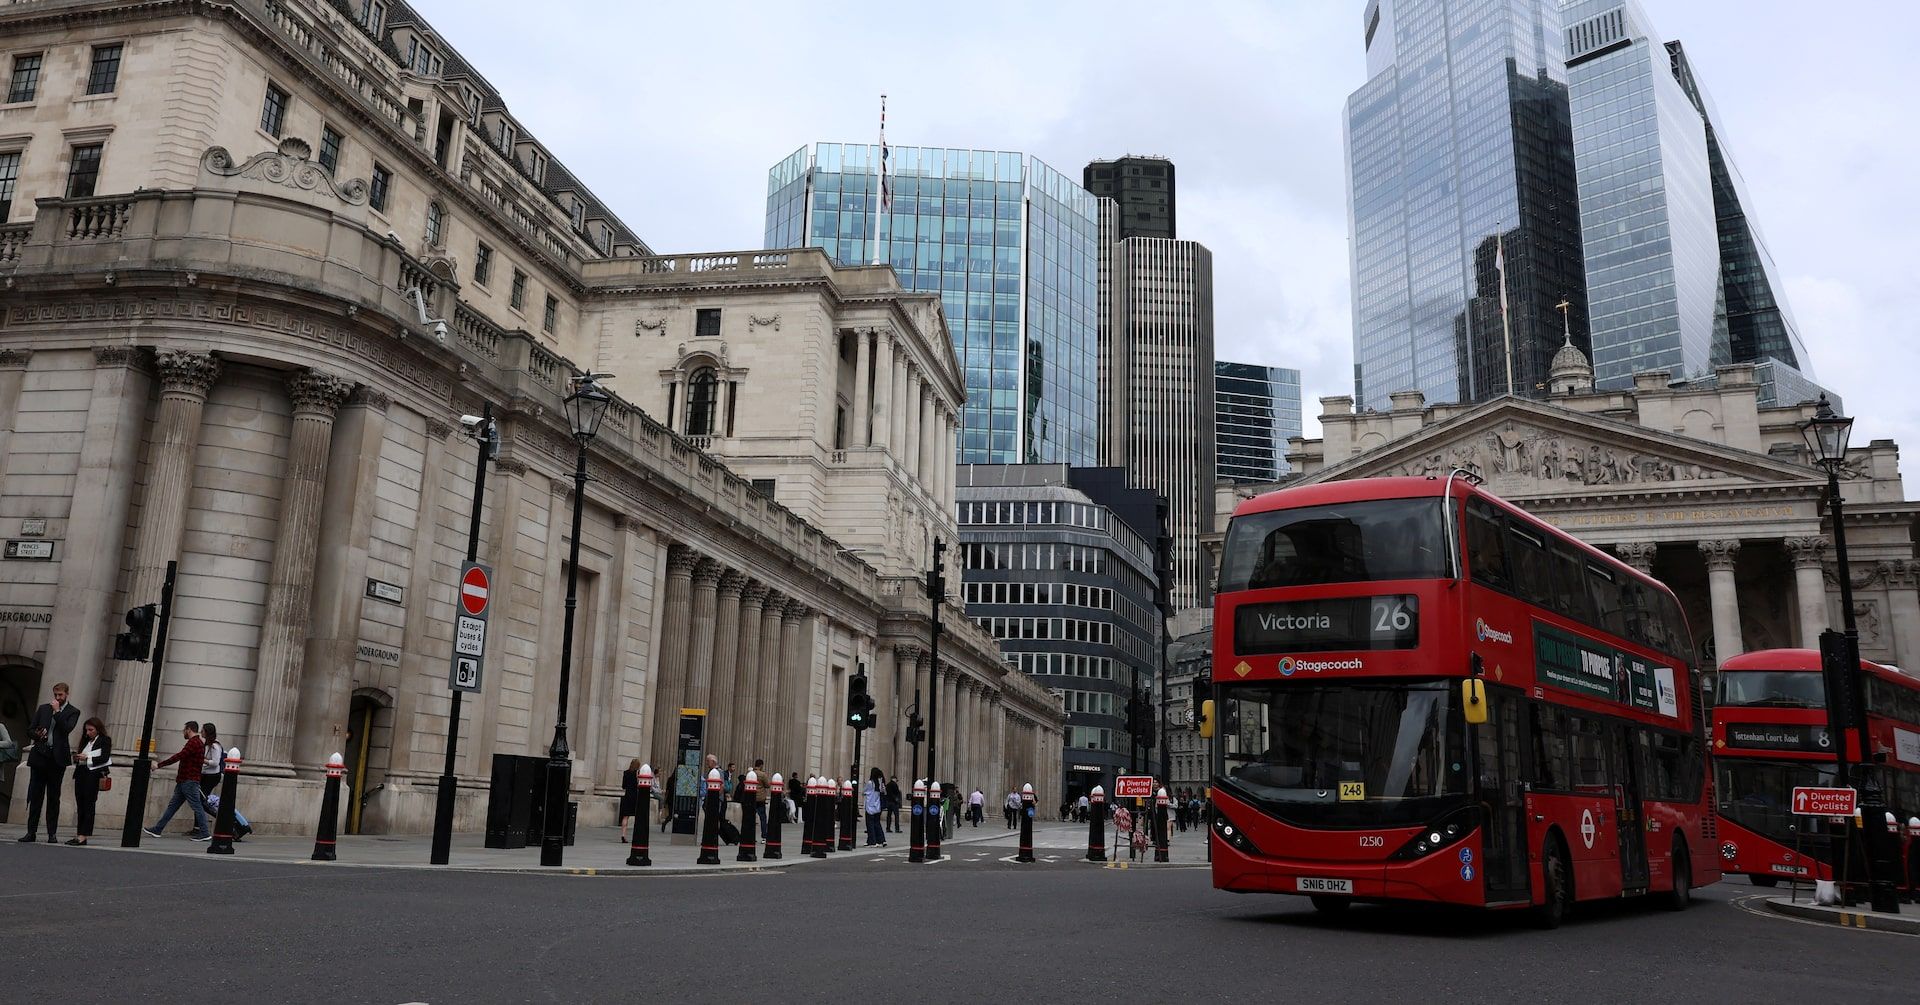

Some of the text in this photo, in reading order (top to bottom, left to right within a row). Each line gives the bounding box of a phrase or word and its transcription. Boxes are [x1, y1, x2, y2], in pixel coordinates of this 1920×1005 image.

[1257, 602, 1411, 632] Victoria 26
[462, 620, 482, 632] Except
[460, 631, 482, 642] buses &
[1485, 624, 1513, 645] Stagecoach
[461, 641, 478, 651] cycles
[1296, 658, 1362, 672] Stagecoach
[1581, 649, 1588, 673] TO
[1734, 731, 1831, 748] Tottenham Court Road 8
[1126, 779, 1150, 787] Diverted
[1343, 784, 1362, 796] 248
[1810, 792, 1851, 802] Diverted
[1811, 801, 1849, 811] Cyclists
[1359, 836, 1384, 847] 12510
[1302, 879, 1347, 891] SN16 OHZ
